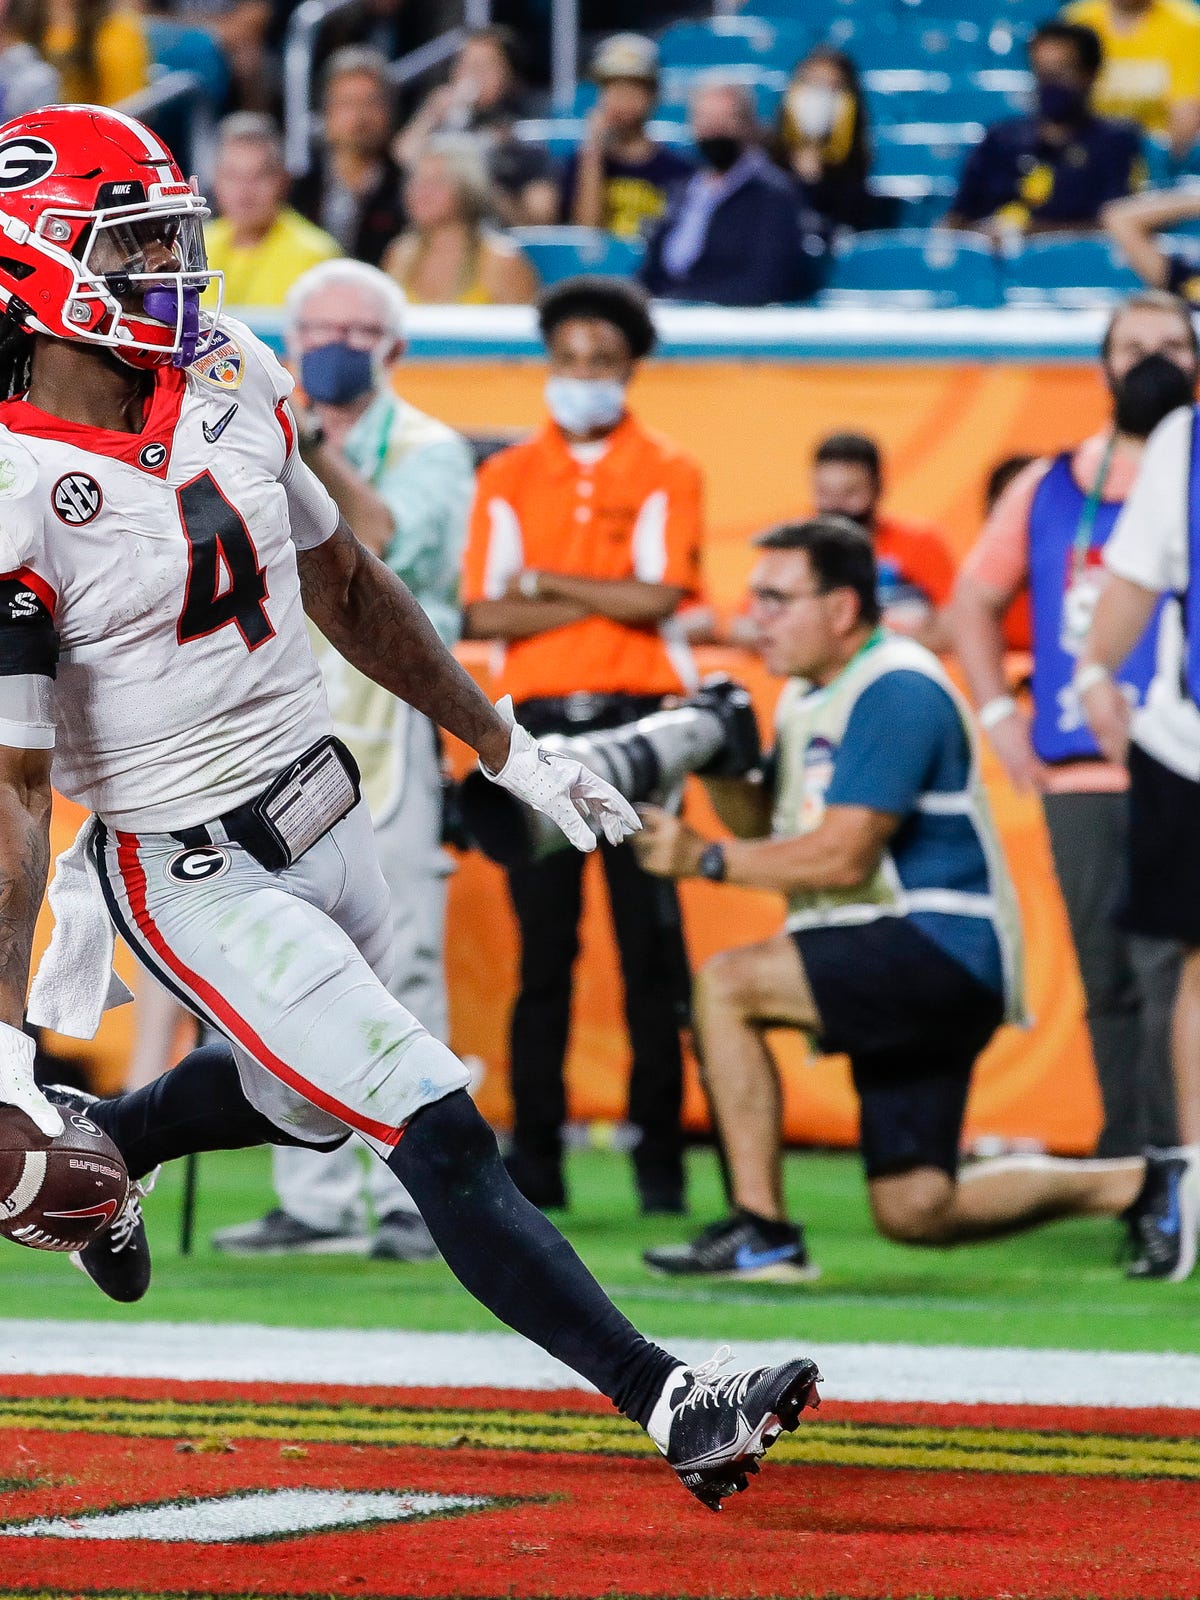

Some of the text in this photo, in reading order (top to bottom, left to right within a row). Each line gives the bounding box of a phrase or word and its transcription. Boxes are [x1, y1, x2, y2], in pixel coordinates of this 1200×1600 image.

[112, 184, 131, 195] NIKE
[143, 445, 166, 465] G
[55, 475, 99, 524] SEC
[175, 468, 277, 653] 4
[69, 1159, 100, 1172] ELITE
